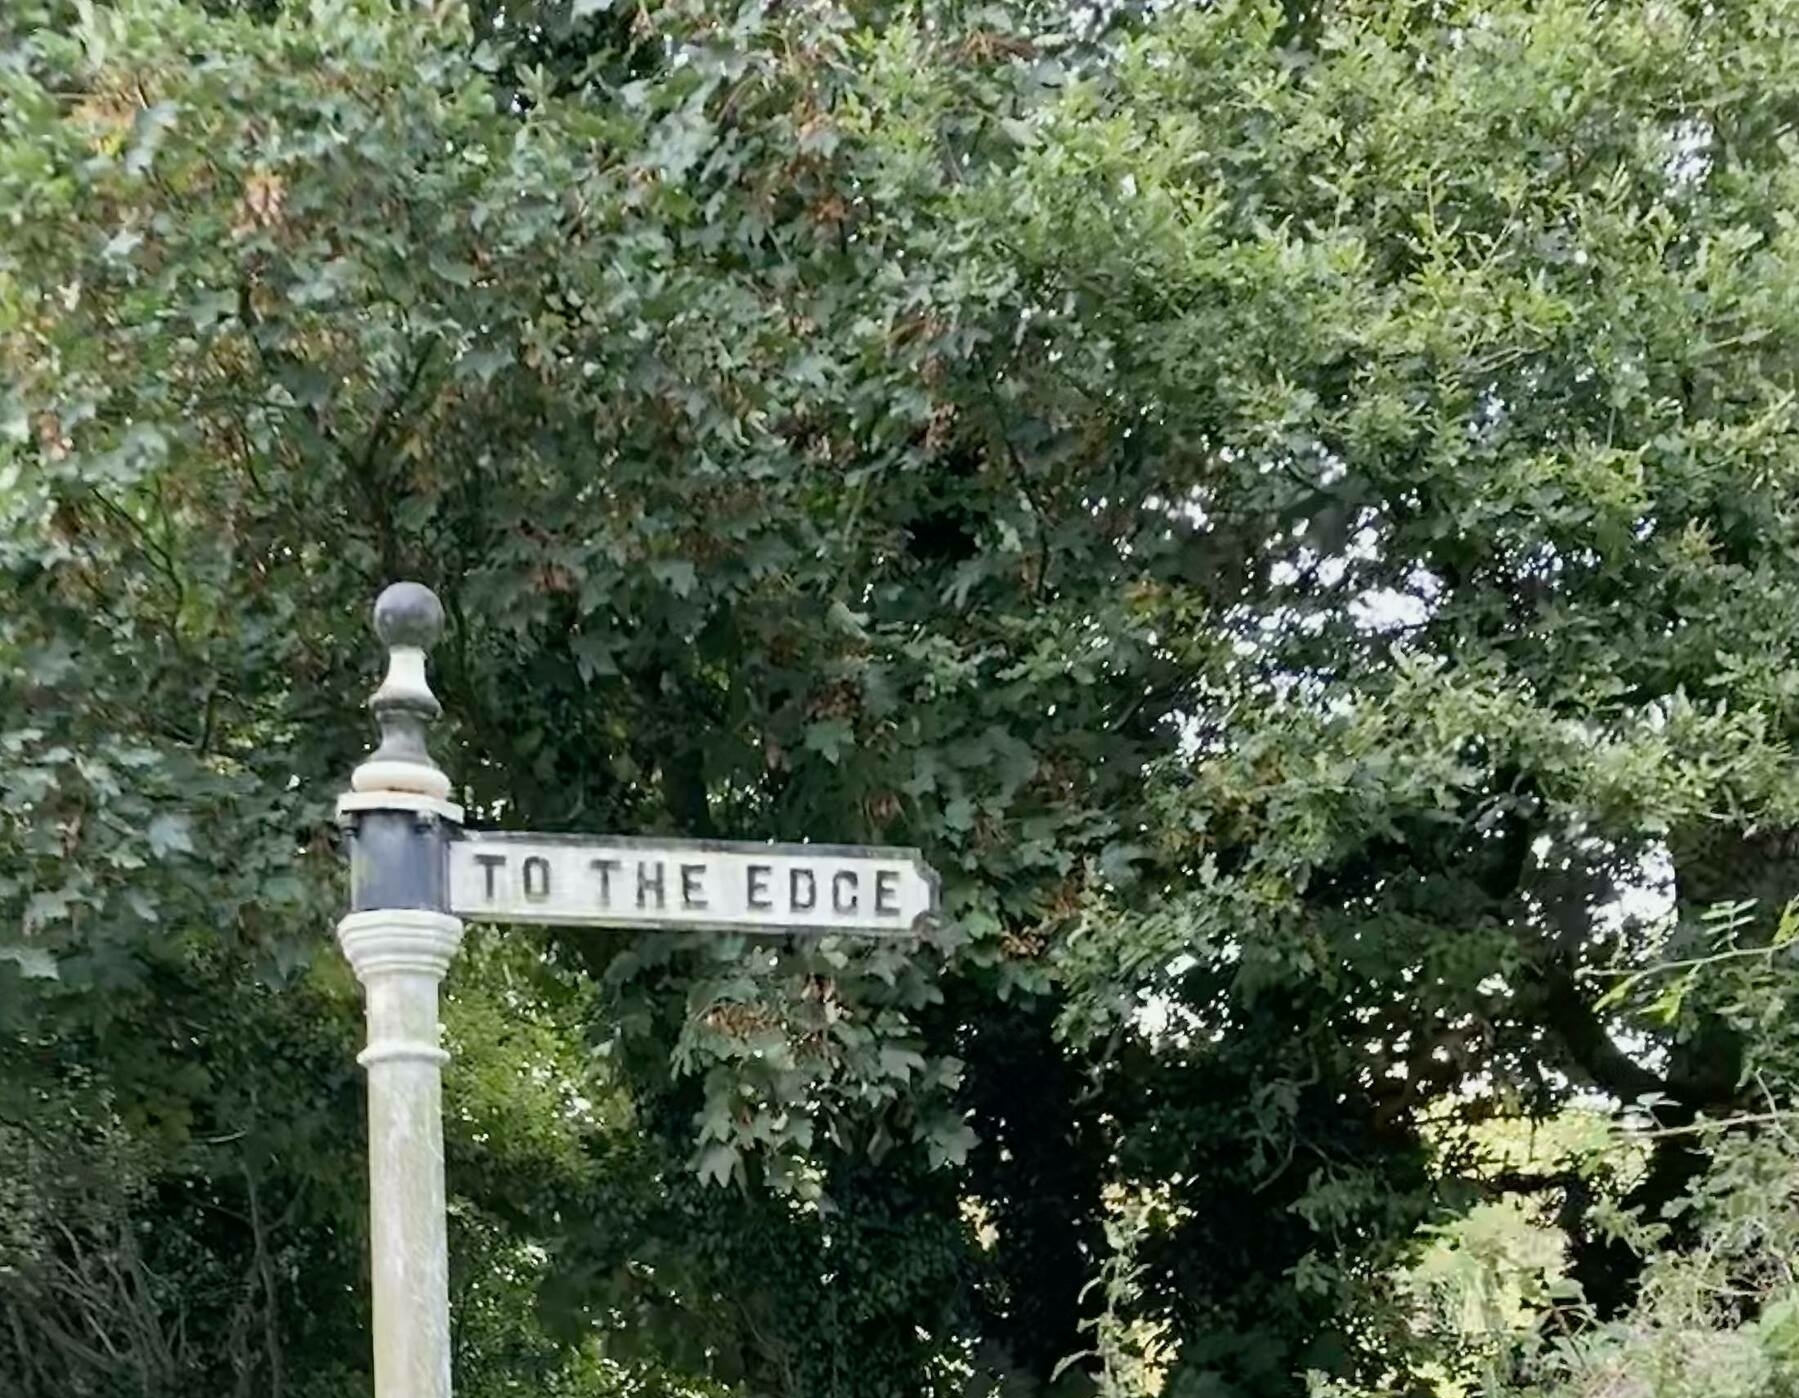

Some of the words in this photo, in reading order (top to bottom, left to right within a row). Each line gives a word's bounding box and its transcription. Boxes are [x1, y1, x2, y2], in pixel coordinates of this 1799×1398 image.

[474, 854, 550, 899] TO
[590, 859, 708, 910] THE
[747, 865, 901, 916] EDGE
